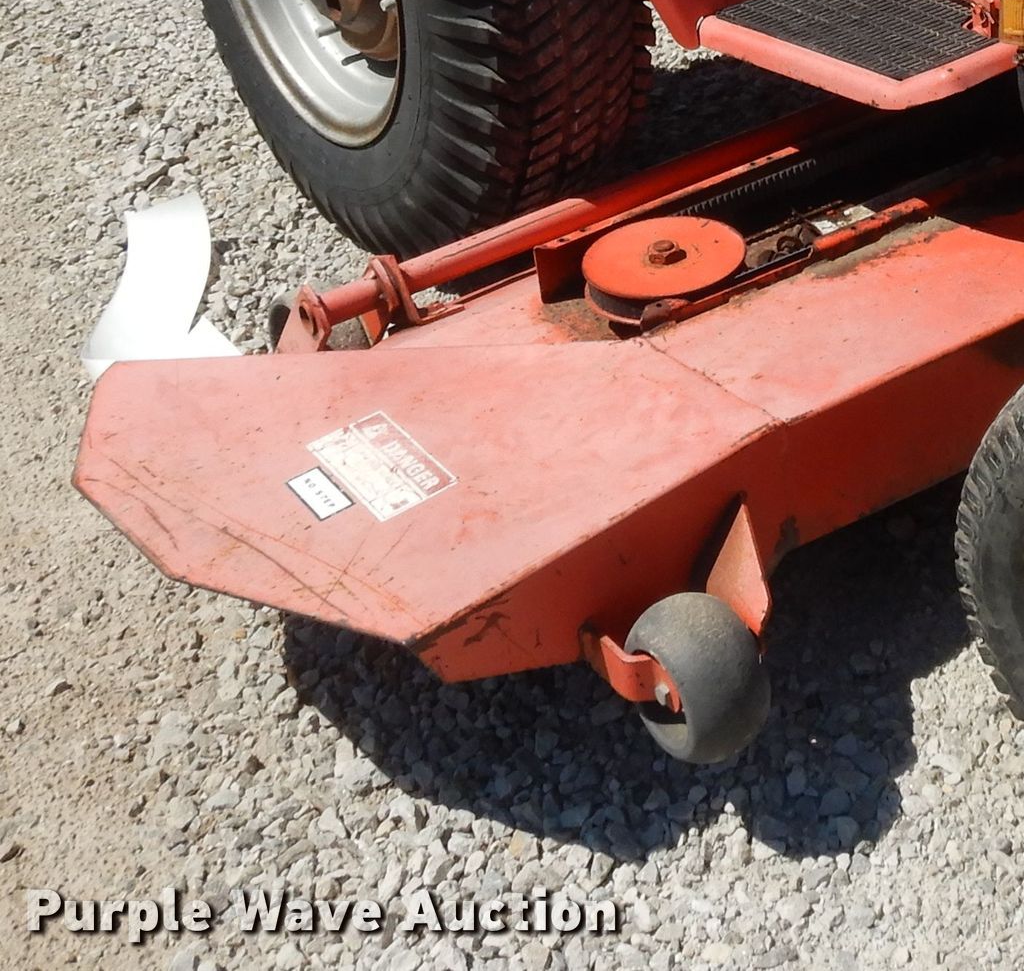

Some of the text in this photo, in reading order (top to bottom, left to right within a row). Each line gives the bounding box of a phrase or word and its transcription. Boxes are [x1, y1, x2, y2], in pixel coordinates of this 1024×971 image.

[381, 439, 440, 491] DANGER
[304, 477, 336, 508] NO STEP
